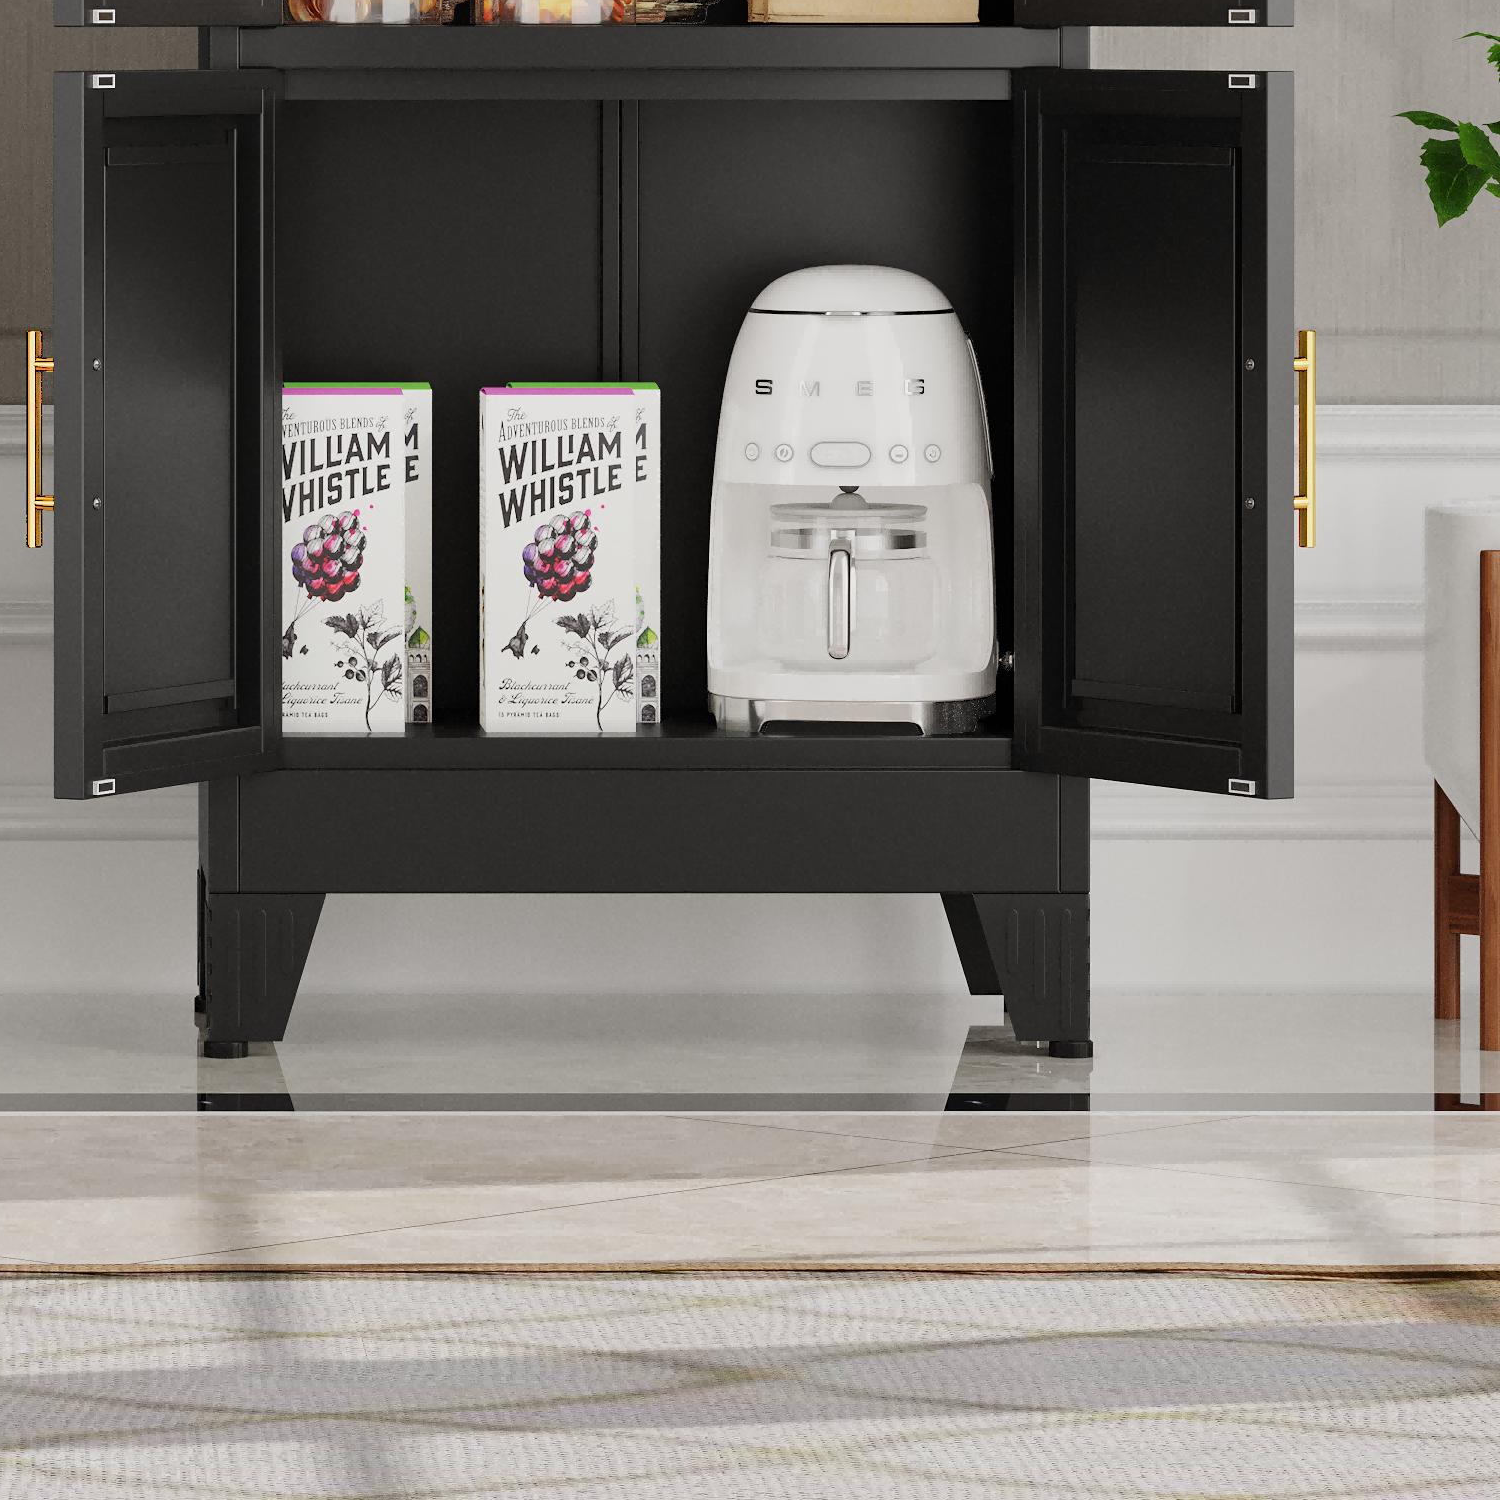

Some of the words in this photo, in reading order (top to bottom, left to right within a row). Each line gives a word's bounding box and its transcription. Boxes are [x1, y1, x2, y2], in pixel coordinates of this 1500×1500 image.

[755, 379, 925, 397] SMEG
[507, 407, 526, 422] The
[282, 419, 337, 438] VENTUROUS
[340, 417, 374, 430] BLENDS
[499, 419, 569, 443] ADVENTUROUS
[571, 417, 606, 431] BLENDS
[498, 431, 622, 485] WILLIAM
[498, 463, 622, 529] WHISTLE
